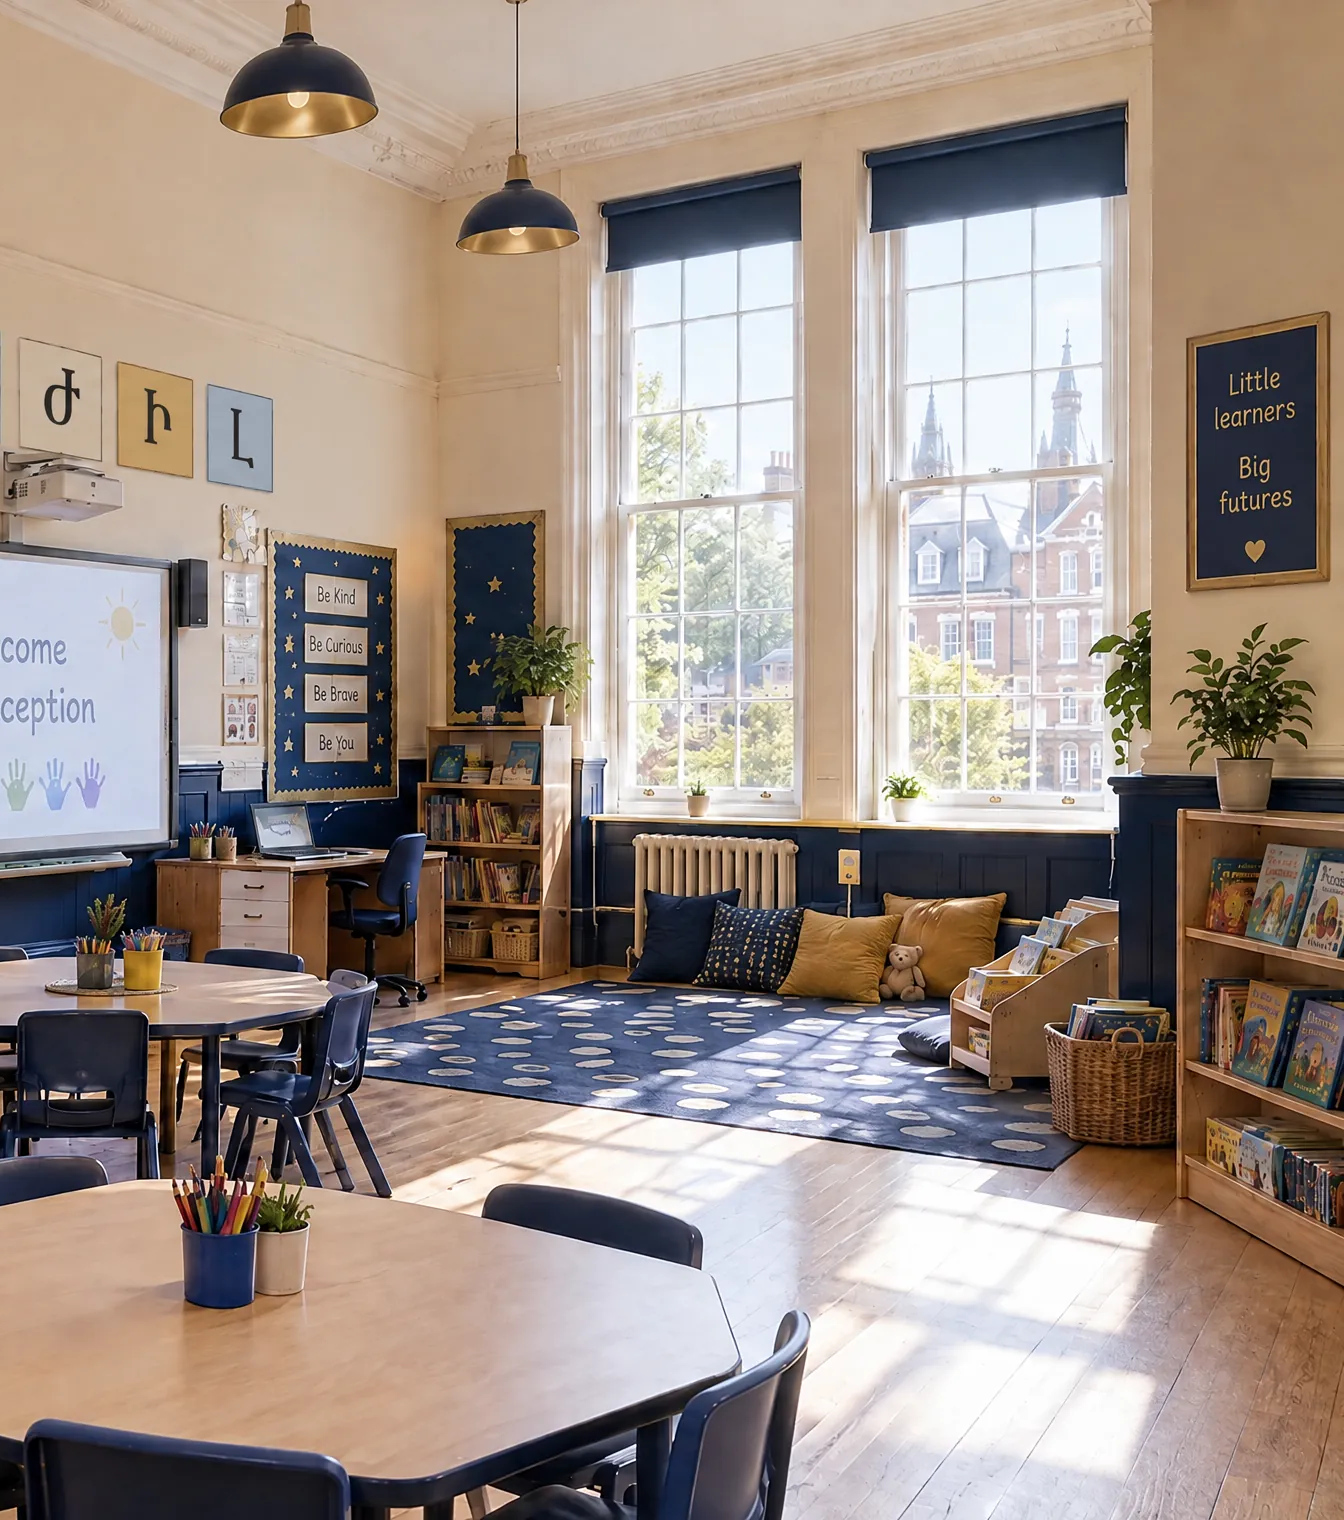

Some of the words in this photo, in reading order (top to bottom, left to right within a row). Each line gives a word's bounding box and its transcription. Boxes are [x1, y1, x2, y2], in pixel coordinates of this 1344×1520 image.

[1229, 366, 1281, 396] Little
[43, 367, 81, 426] Ժ
[144, 387, 172, 445] Ի
[1215, 401, 1295, 430] learners
[230, 407, 254, 469] Լ
[1239, 455, 1270, 484] Big
[1219, 489, 1292, 515] futures
[317, 585, 331, 603] Be
[334, 587, 356, 605] Kind
[309, 635, 323, 652] Be
[325, 637, 363, 655] Curious
[313, 684, 327, 702] Be
[330, 685, 359, 702] Brave
[319, 734, 333, 751] Be
[335, 735, 355, 750] You
